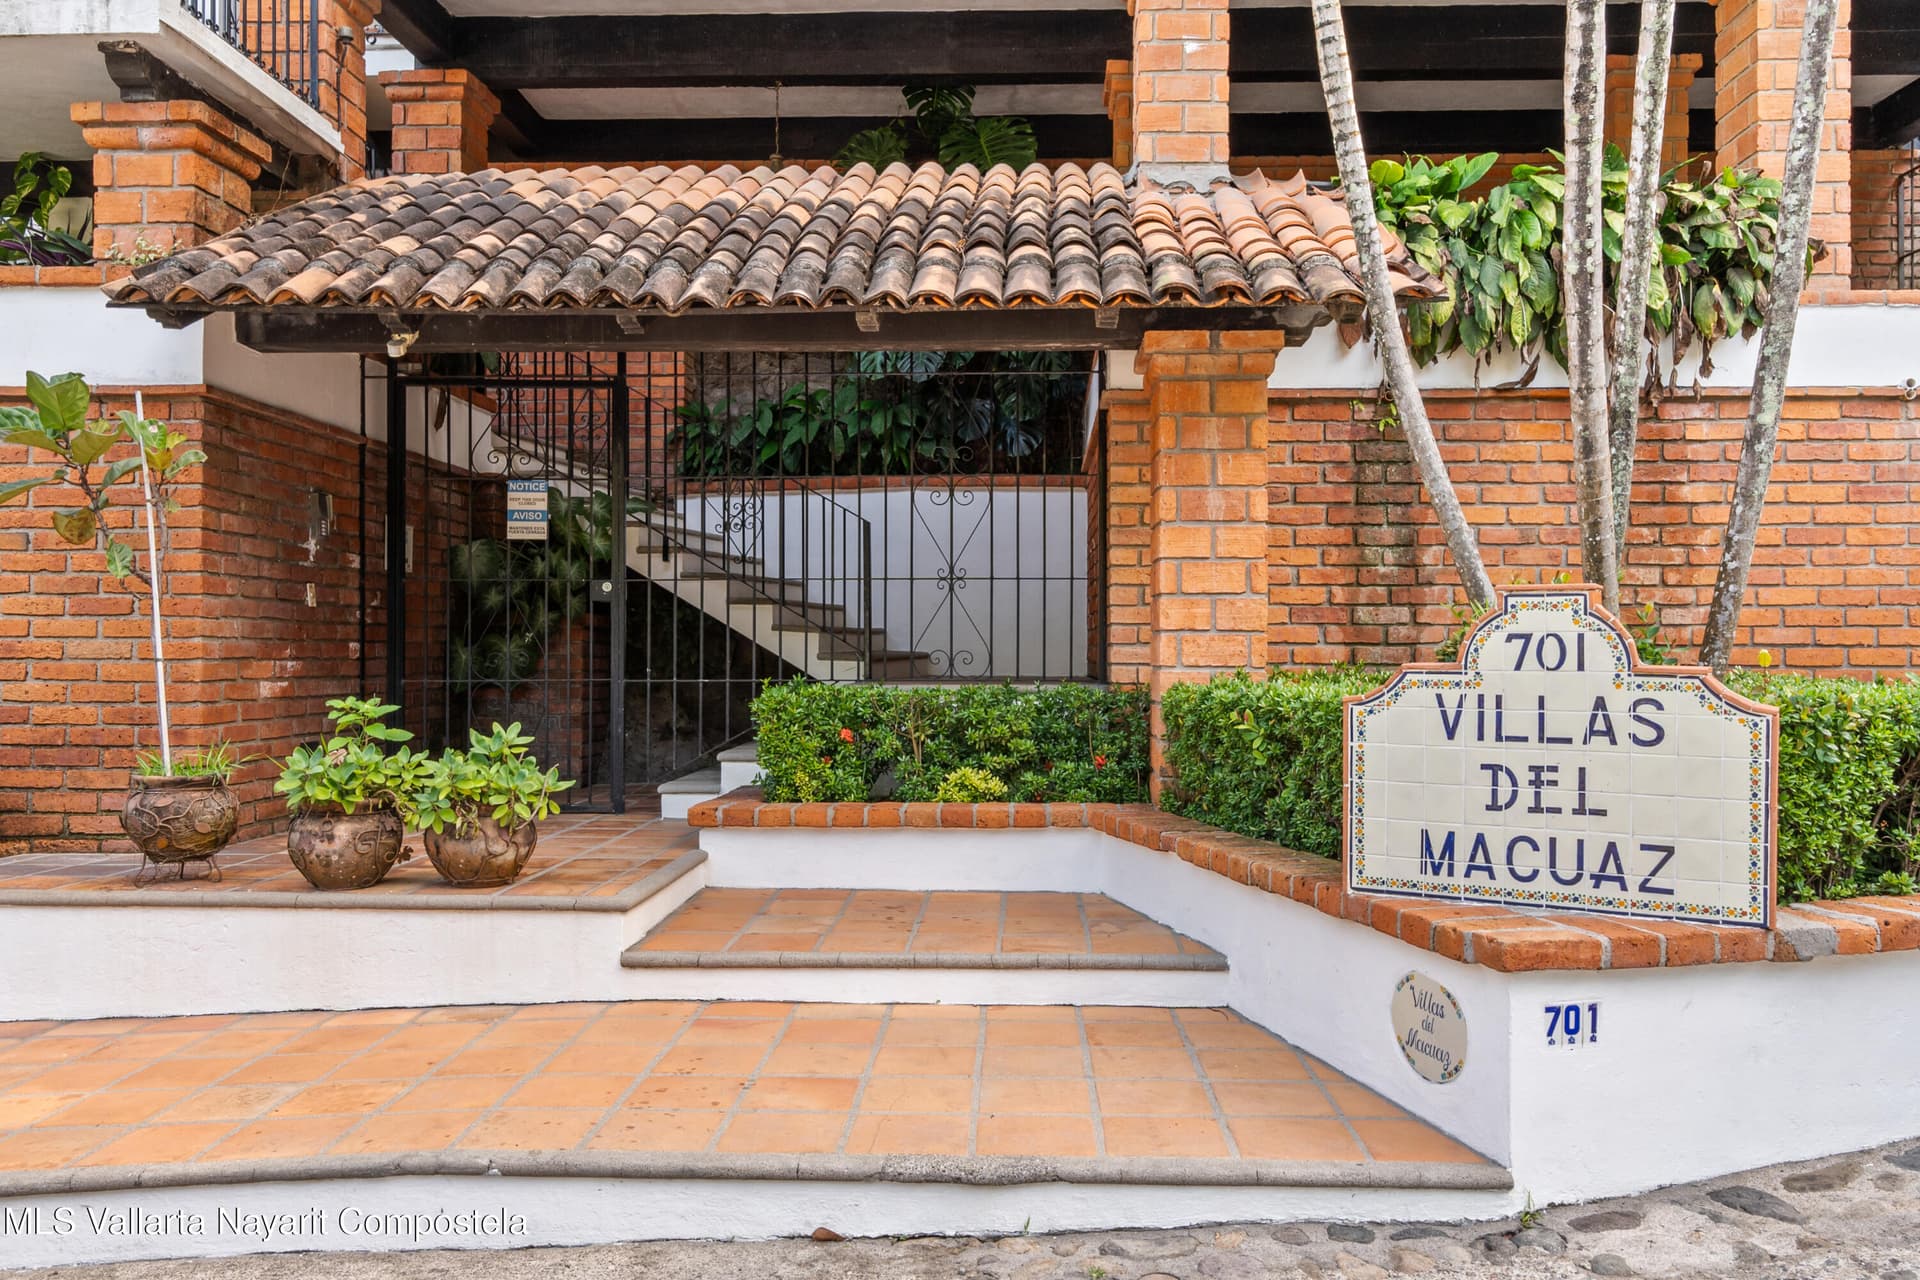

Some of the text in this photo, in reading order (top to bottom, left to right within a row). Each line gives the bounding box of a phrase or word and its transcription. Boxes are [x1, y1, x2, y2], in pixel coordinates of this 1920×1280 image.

[509, 482, 545, 491] NOTICE
[512, 511, 542, 520] AVISO
[1505, 632, 1585, 673] 701
[1435, 692, 1666, 748] VILLAS
[1480, 763, 1608, 818] DEL
[1419, 828, 1676, 896] MACUAZ
[1410, 984, 1445, 1019] Villas
[1544, 1003, 1598, 1038] 701
[1421, 1015, 1435, 1034] del
[1405, 1028, 1452, 1071] Macuaz
